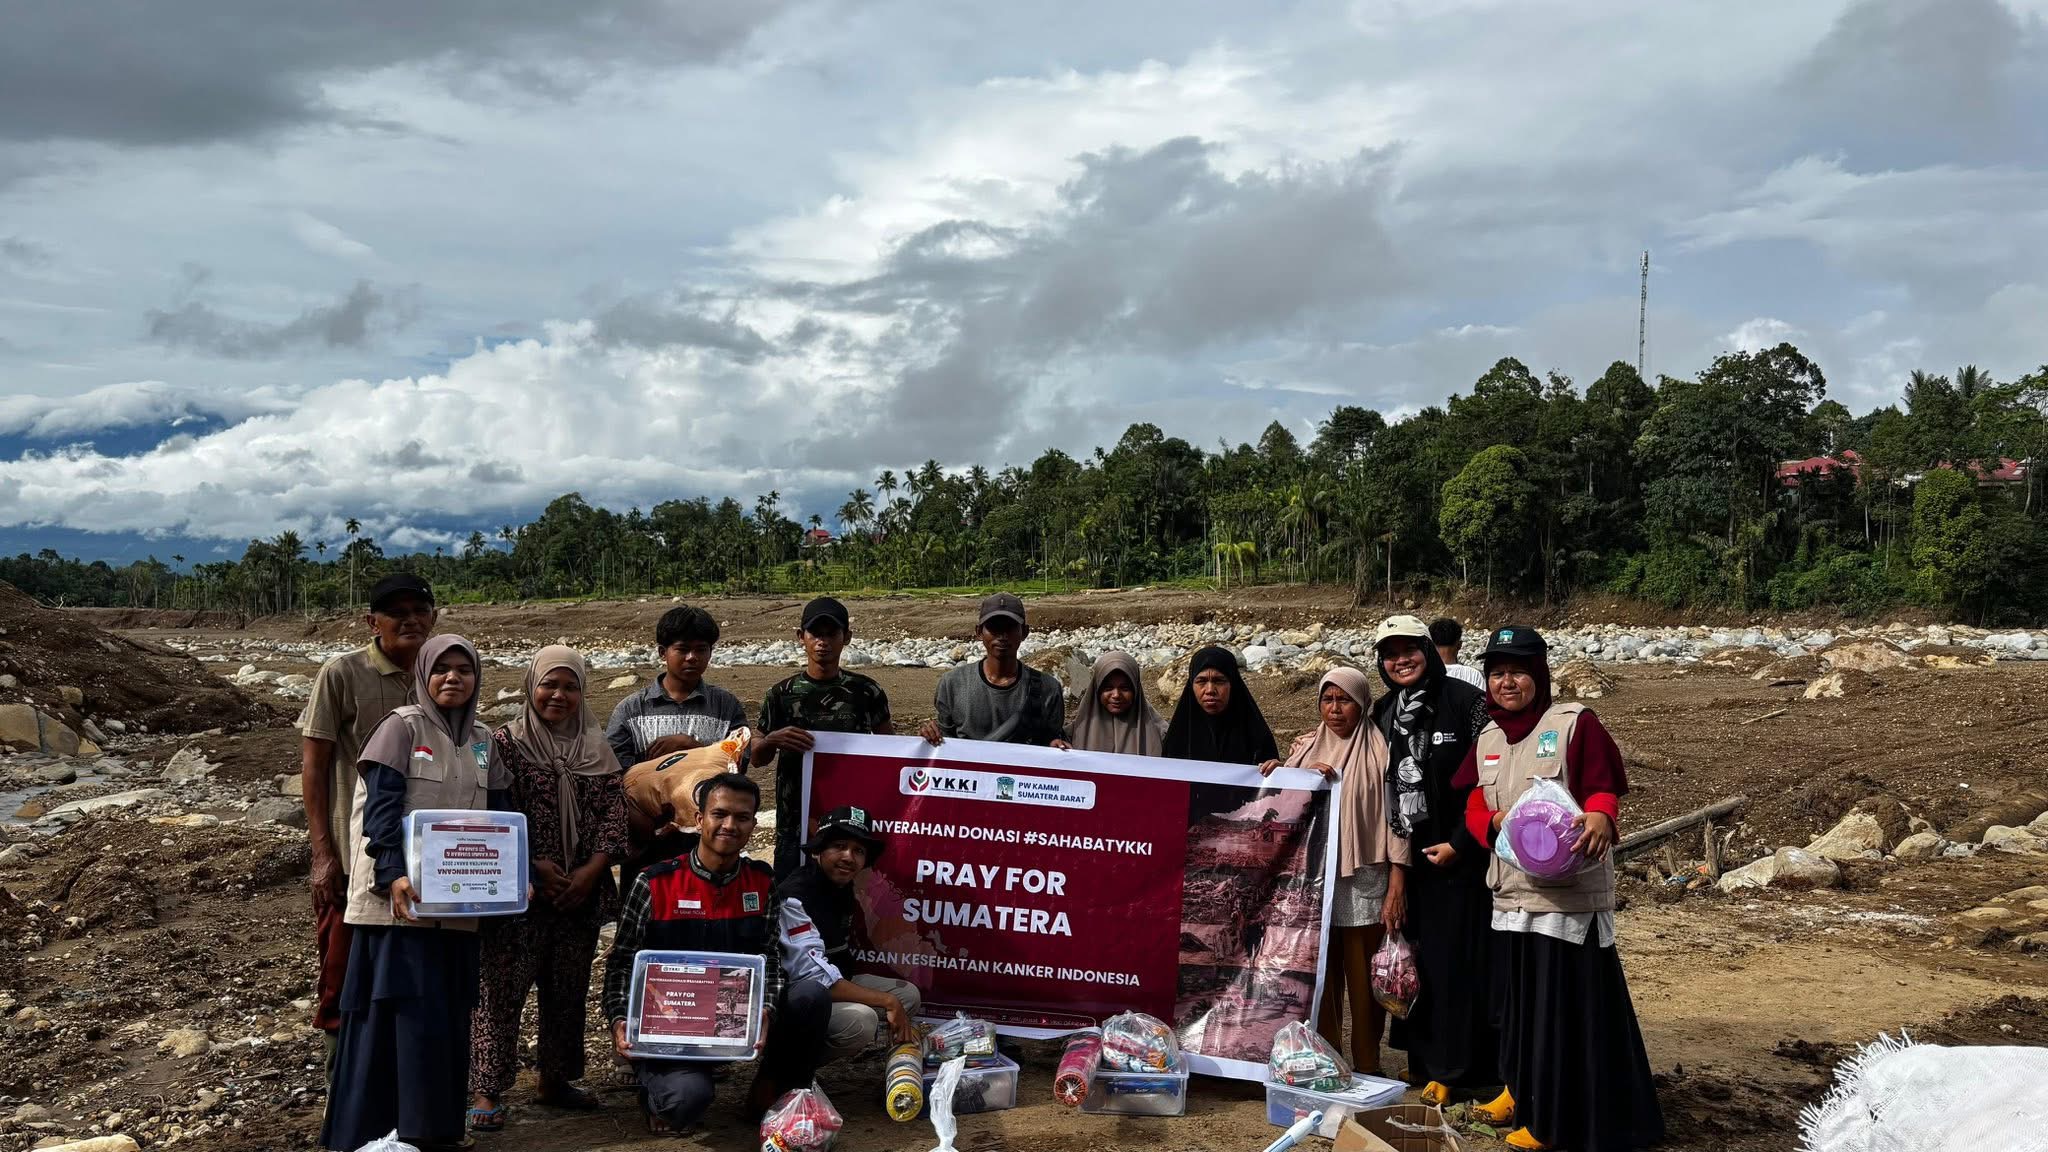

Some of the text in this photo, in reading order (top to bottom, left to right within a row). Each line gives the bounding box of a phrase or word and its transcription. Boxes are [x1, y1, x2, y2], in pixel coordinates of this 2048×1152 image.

[931, 776, 977, 791] YKKI
[1017, 791, 1059, 801] SUMATERA
[1060, 795, 1086, 804] BARAT
[1032, 783, 1060, 792] KAMMI
[871, 819, 955, 838] NYERAHAN
[958, 826, 1020, 843] DONASI
[1023, 831, 1152, 856] #SAHABATYKKI
[916, 859, 1067, 896] PRAY FOR
[902, 898, 1072, 937] SUMATERA
[849, 949, 1141, 986] YASAN KESEHATAN KANKER INDONESIA
